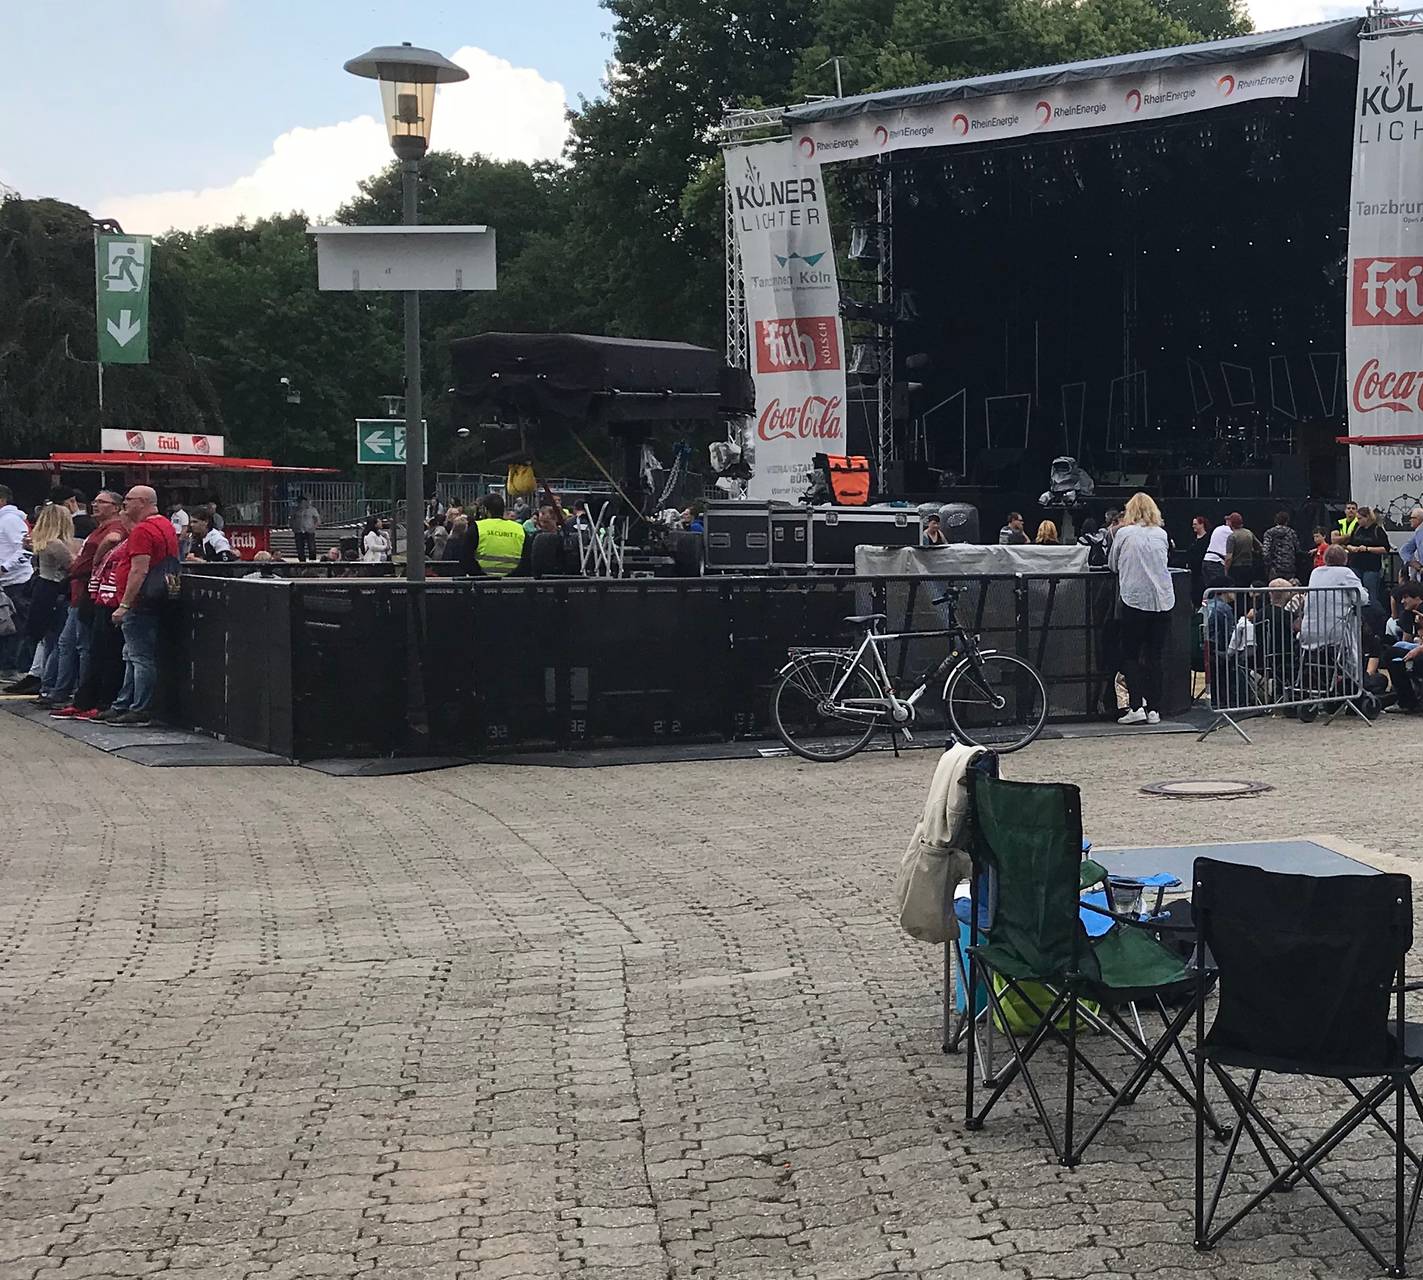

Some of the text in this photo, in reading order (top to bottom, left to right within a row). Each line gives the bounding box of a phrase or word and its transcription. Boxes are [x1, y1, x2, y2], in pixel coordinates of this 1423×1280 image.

[1237, 73, 1295, 90] RheinEnergie
[1143, 88, 1196, 104] RheinEnergie
[1053, 102, 1107, 118] RheinEnergie
[971, 116, 1019, 129] RheinEnergie
[816, 137, 859, 151] RheinEnergie
[741, 208, 820, 231] LICHTER
[799, 270, 831, 284] Köln
[758, 395, 843, 441] Coca-Cola
[158, 435, 180, 451] früh
[1374, 473, 1405, 482] Werner
[230, 531, 256, 549] früh
